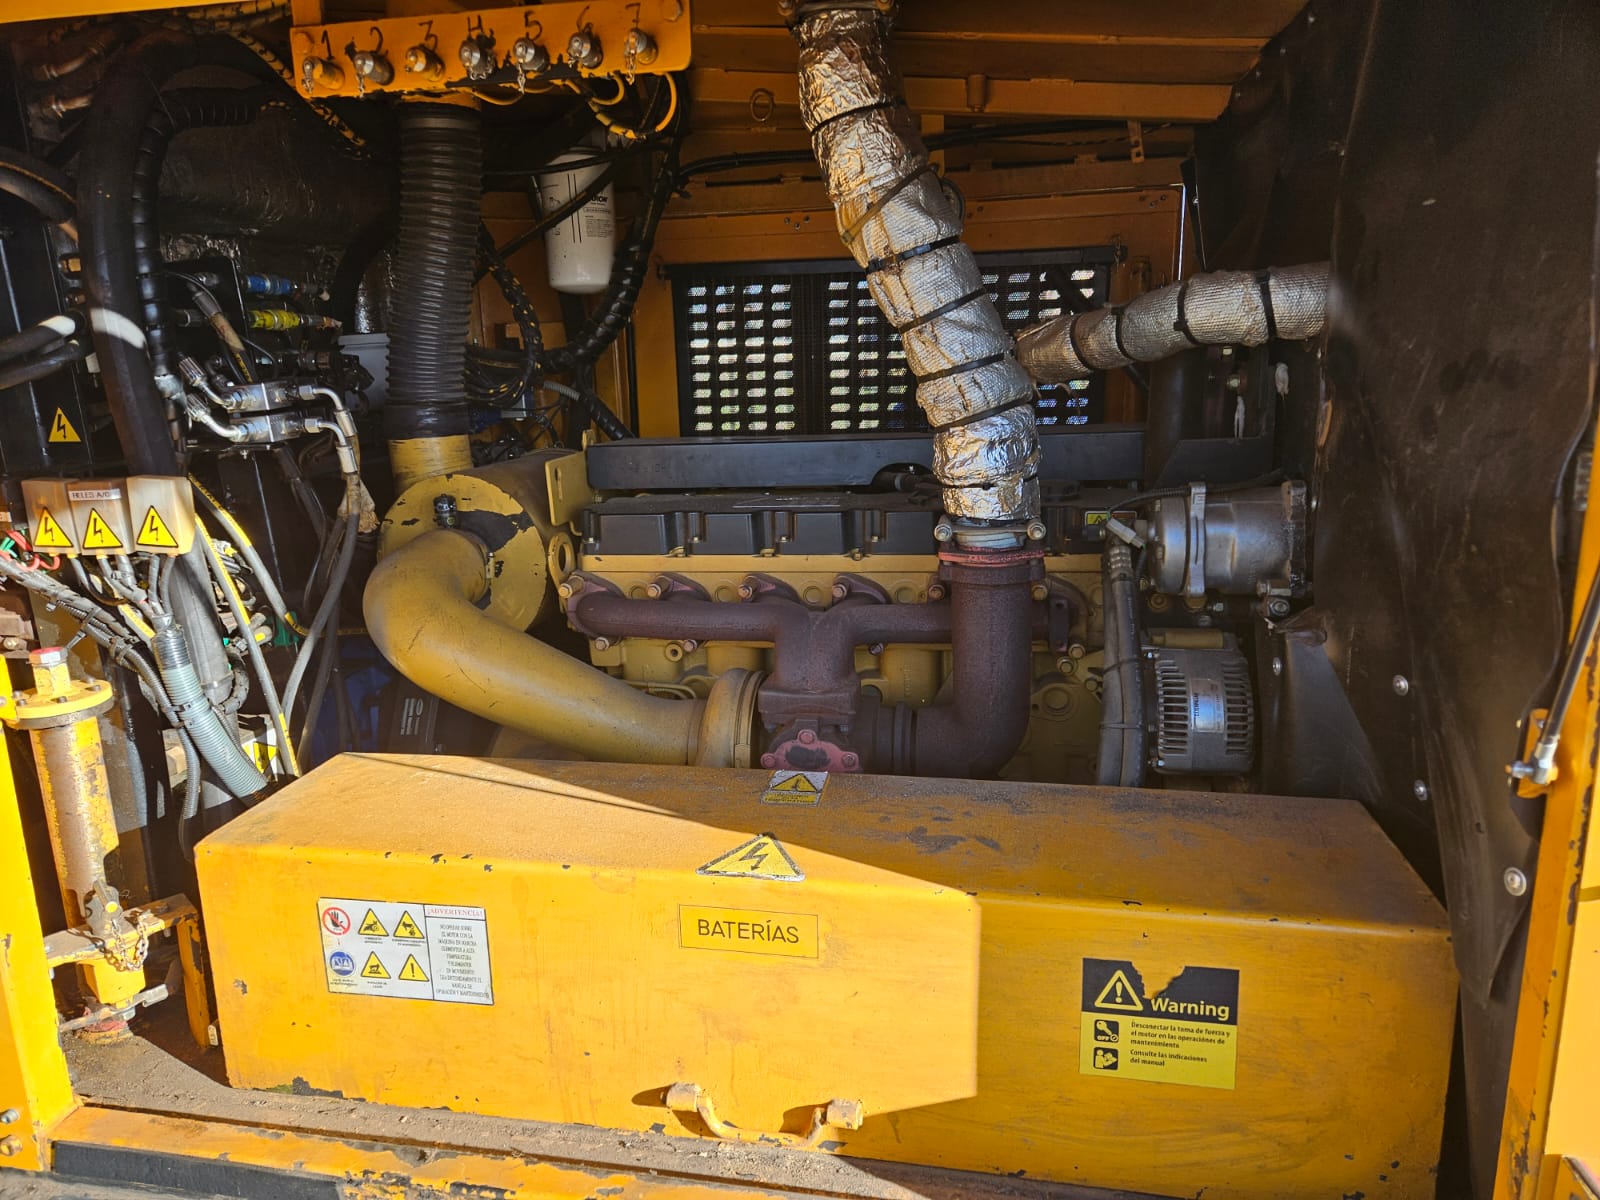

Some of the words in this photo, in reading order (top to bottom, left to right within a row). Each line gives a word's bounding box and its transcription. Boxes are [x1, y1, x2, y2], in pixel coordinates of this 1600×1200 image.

[321, 30, 334, 60] 1
[419, 20, 438, 50] 3
[523, 10, 542, 42] 5
[697, 919, 799, 944] BATERÍAS
[1151, 998, 1230, 1021] Warning
[1131, 1021, 1169, 1031] Desconectar
[1205, 1028, 1226, 1036] fuerza
[1130, 1039, 1180, 1048] mantenimiento
[1130, 1049, 1157, 1058] Consulte
[1169, 1052, 1208, 1063] indicaciones
[1141, 1058, 1165, 1066] manual
